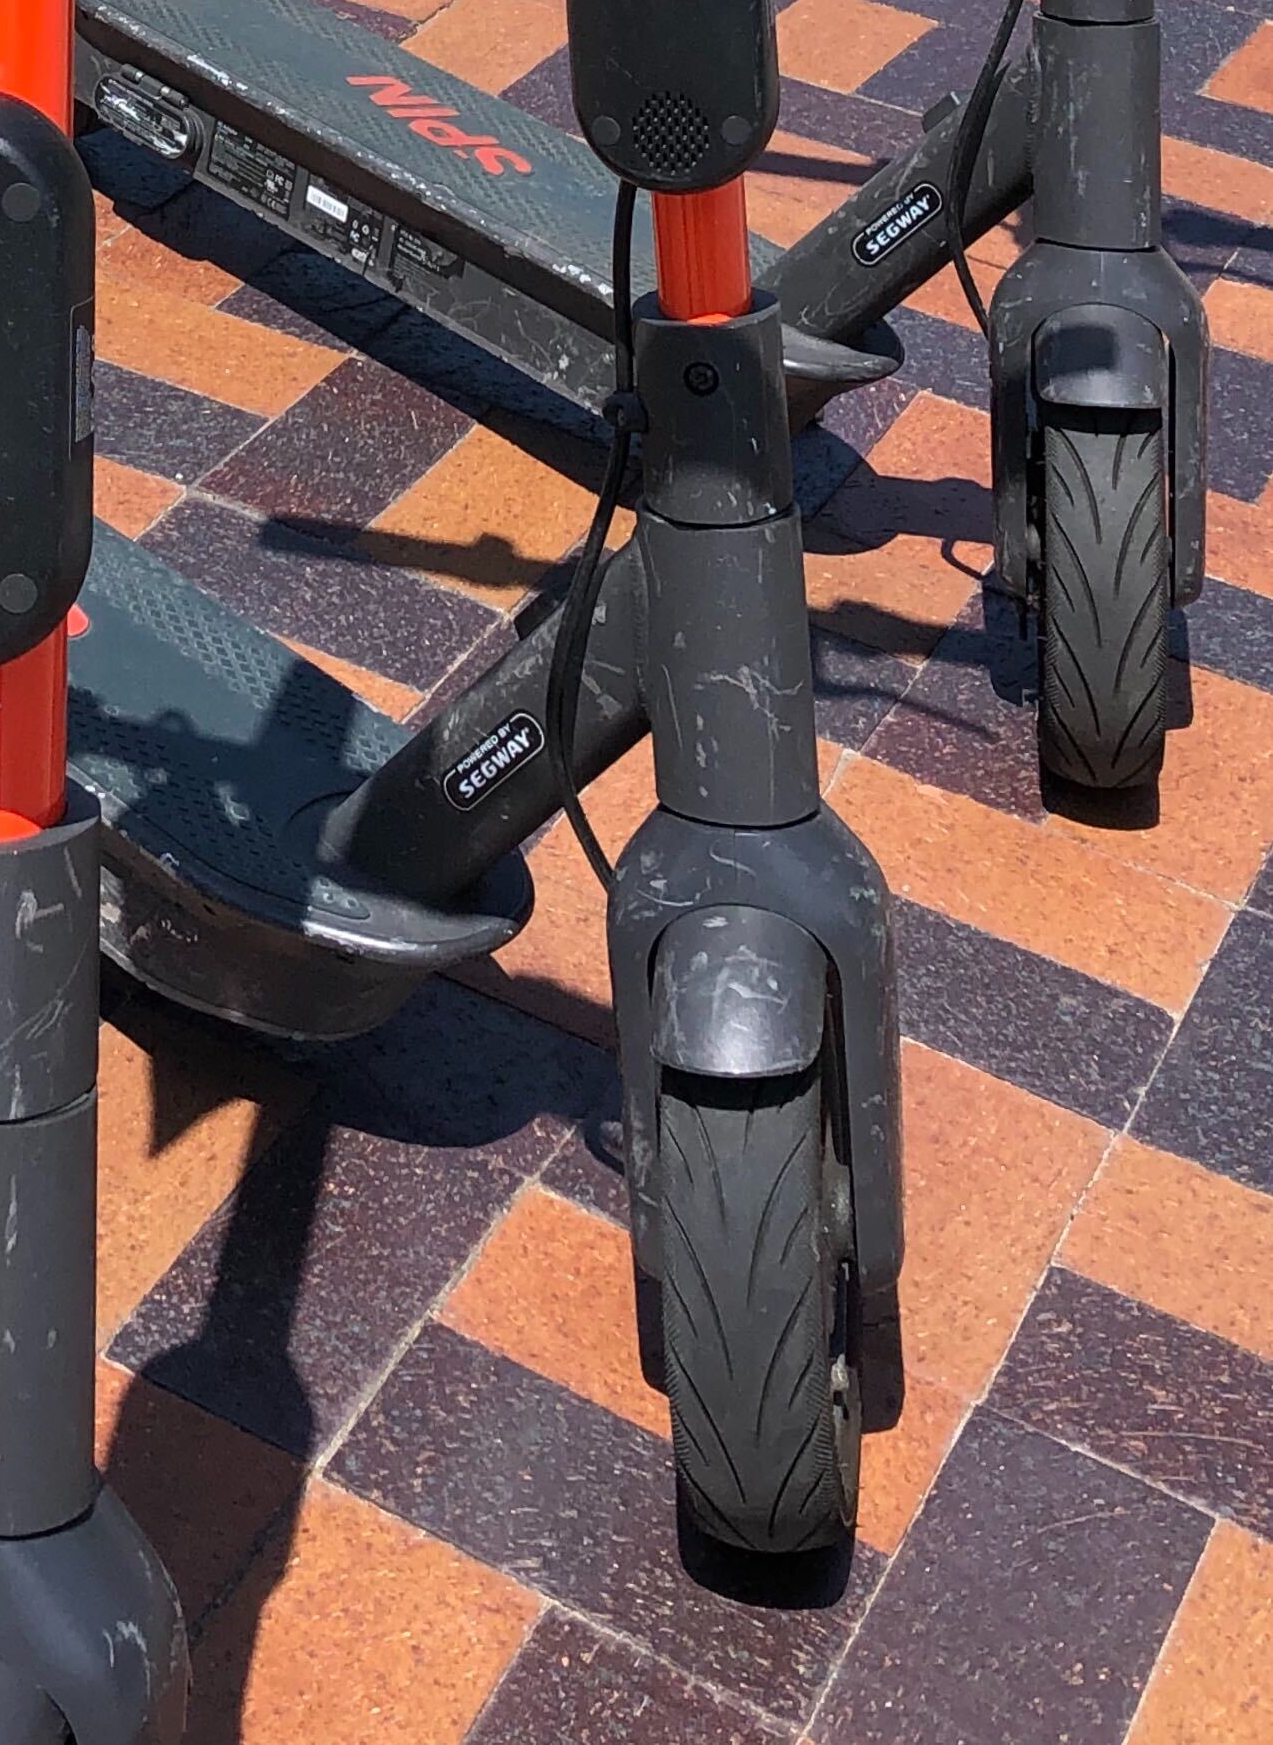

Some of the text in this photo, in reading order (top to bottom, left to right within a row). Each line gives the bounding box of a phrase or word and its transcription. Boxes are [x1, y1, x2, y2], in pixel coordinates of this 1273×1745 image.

[345, 75, 533, 177] SPIN
[865, 195, 930, 255] SEGWAY
[456, 723, 512, 774] POWERED BY
[459, 727, 530, 799] SEGWAY
